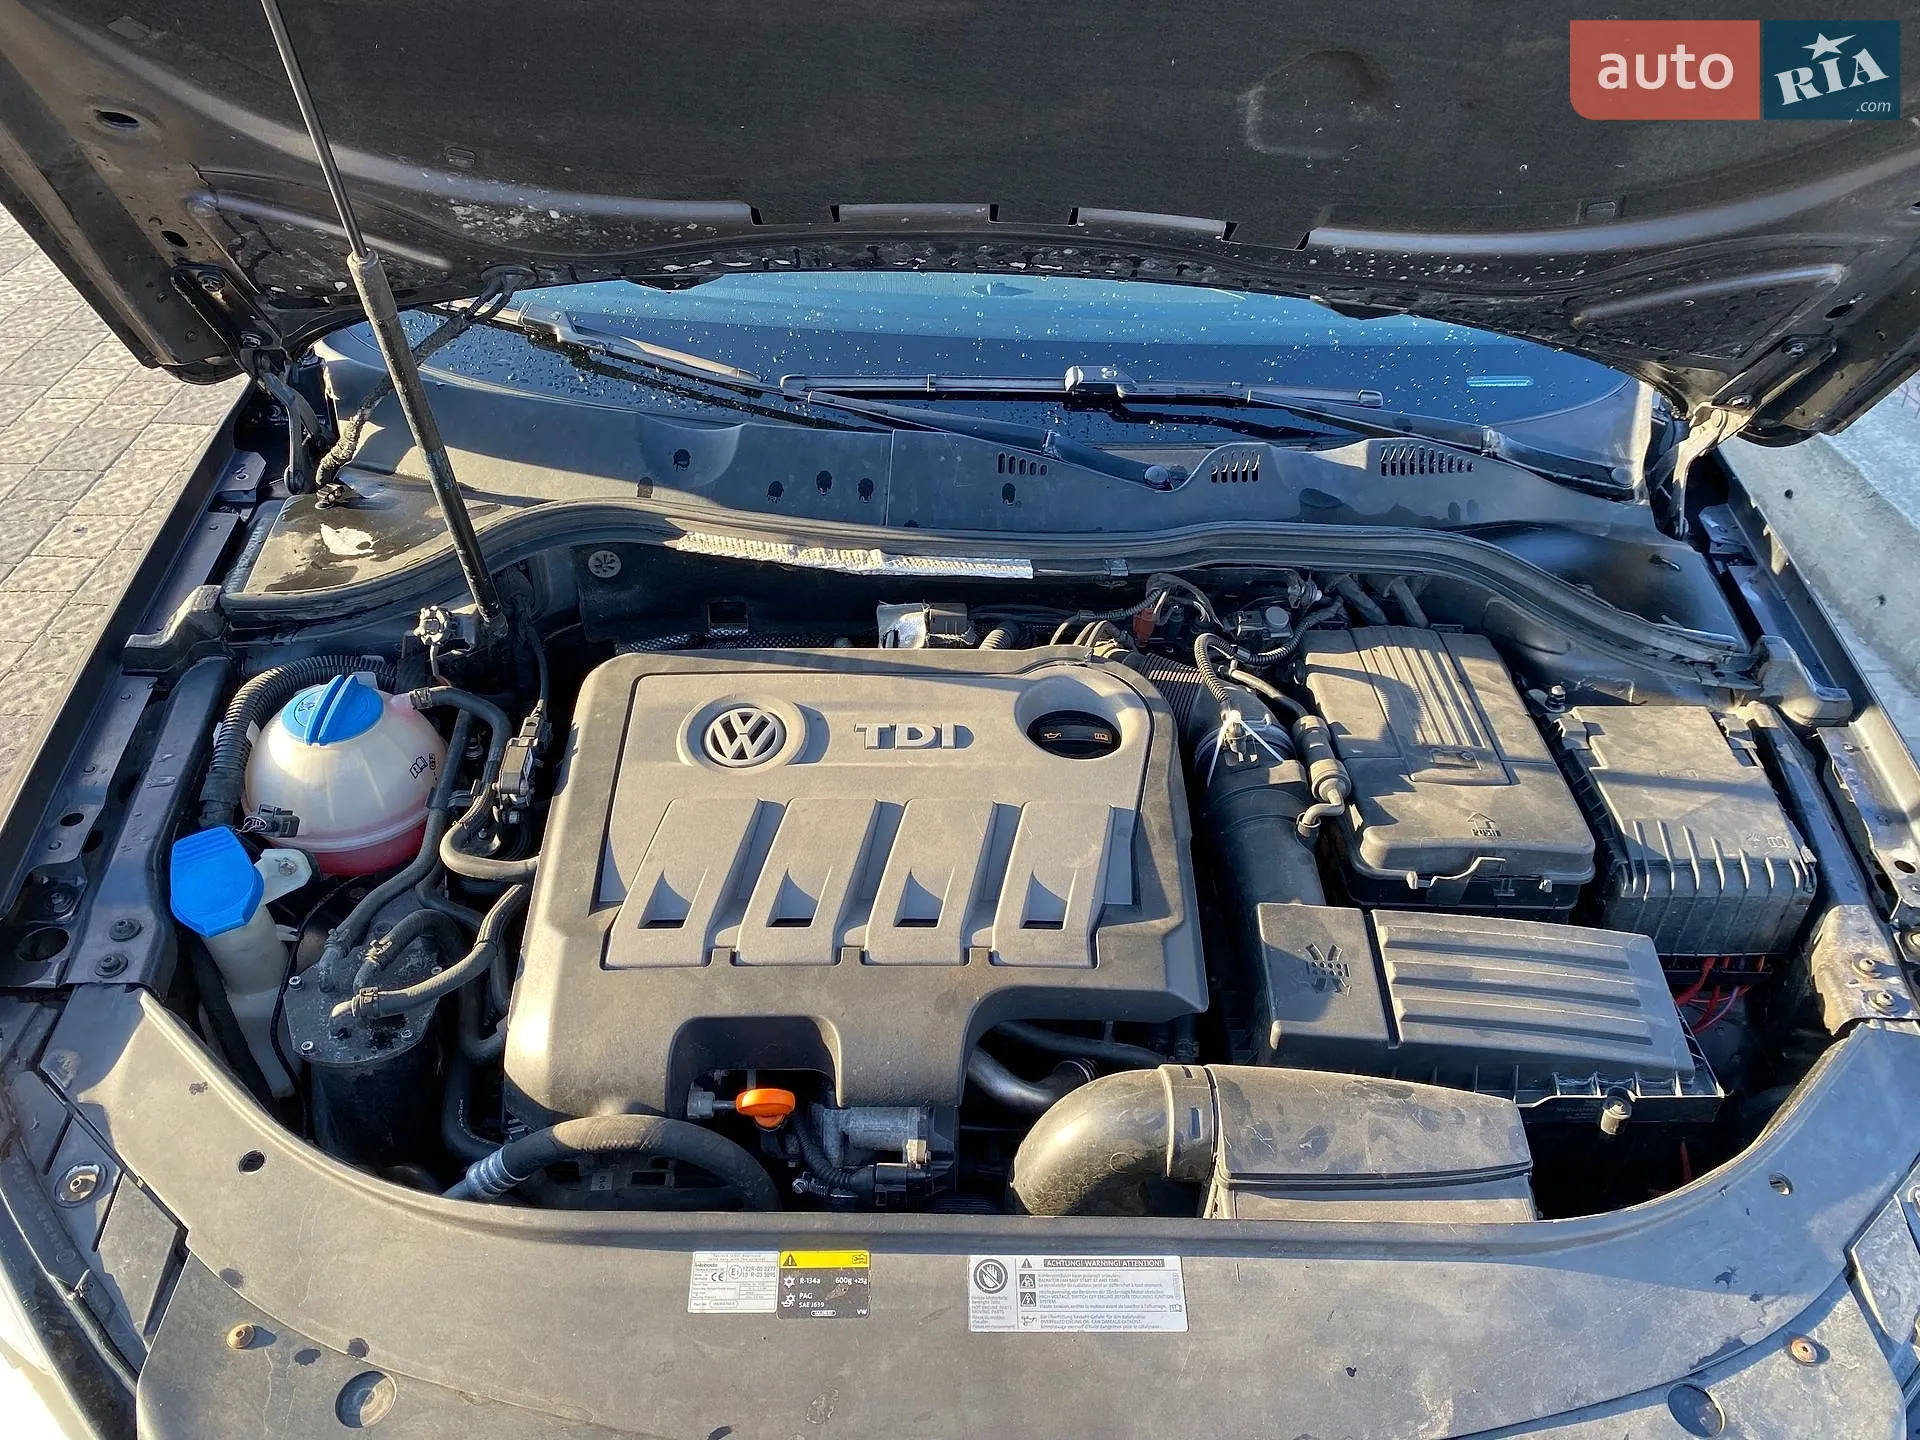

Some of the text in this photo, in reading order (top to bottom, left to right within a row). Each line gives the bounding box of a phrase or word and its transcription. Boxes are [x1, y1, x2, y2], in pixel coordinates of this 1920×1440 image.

[854, 722, 957, 750] TDI
[1047, 1259, 1162, 1267] ACHTUNG! WARNING! ATTENTION!
[835, 1277, 853, 1285] 600g
